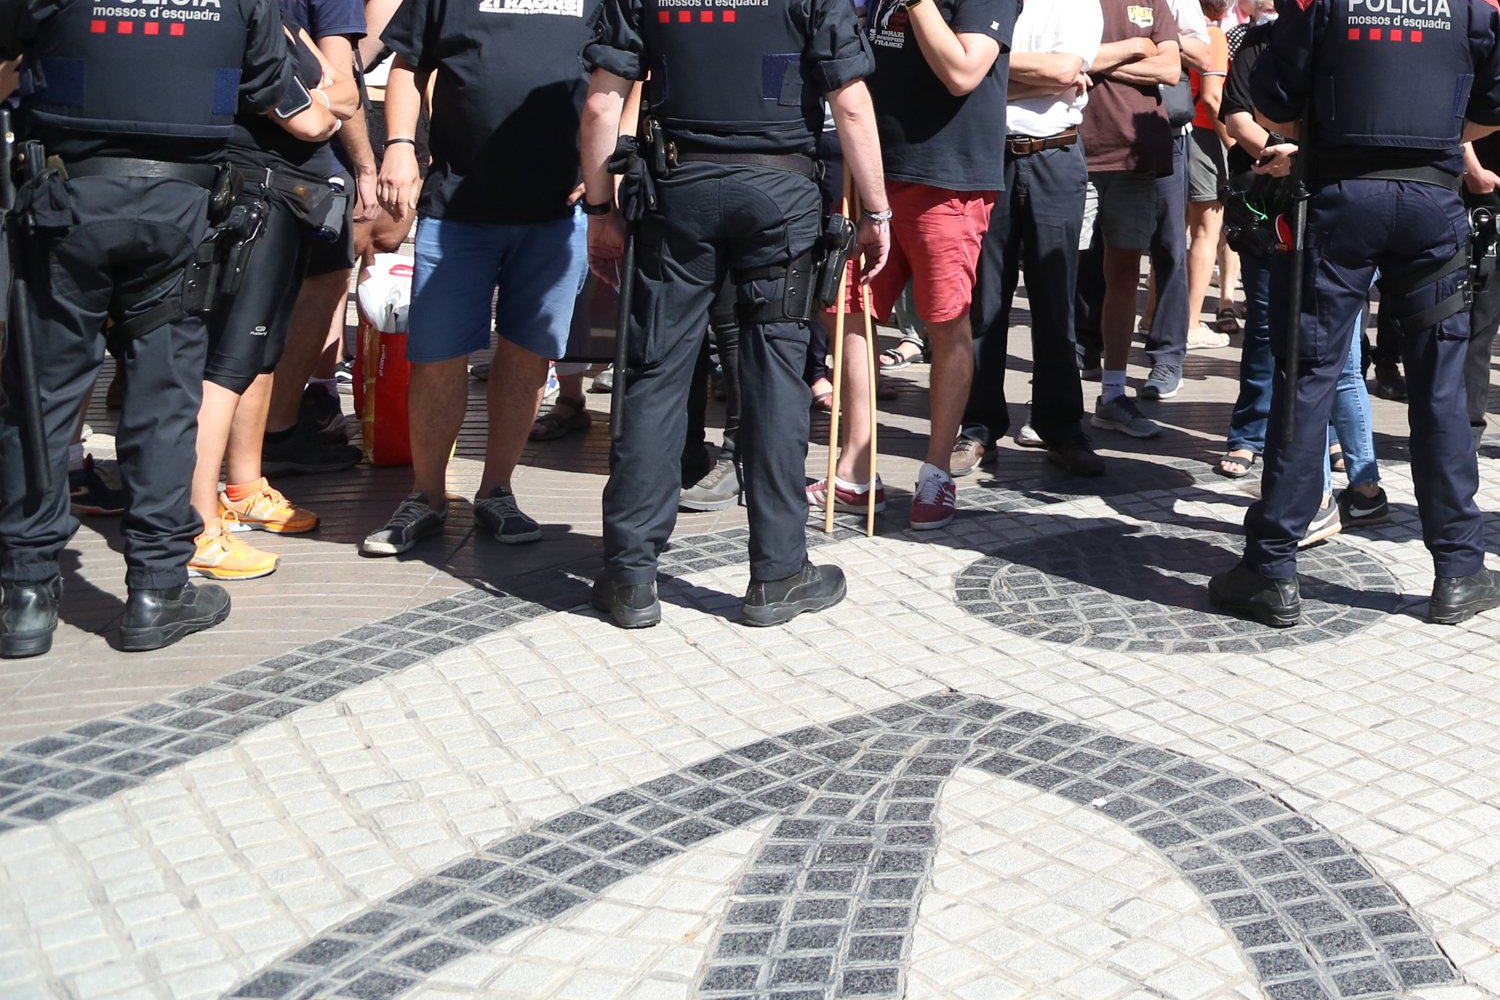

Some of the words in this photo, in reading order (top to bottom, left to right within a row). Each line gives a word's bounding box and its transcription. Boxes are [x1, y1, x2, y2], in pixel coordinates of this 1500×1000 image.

[93, 6, 147, 18] mossos
[1348, 15, 1391, 25] mossos
[874, 39, 903, 48] FRANCE
